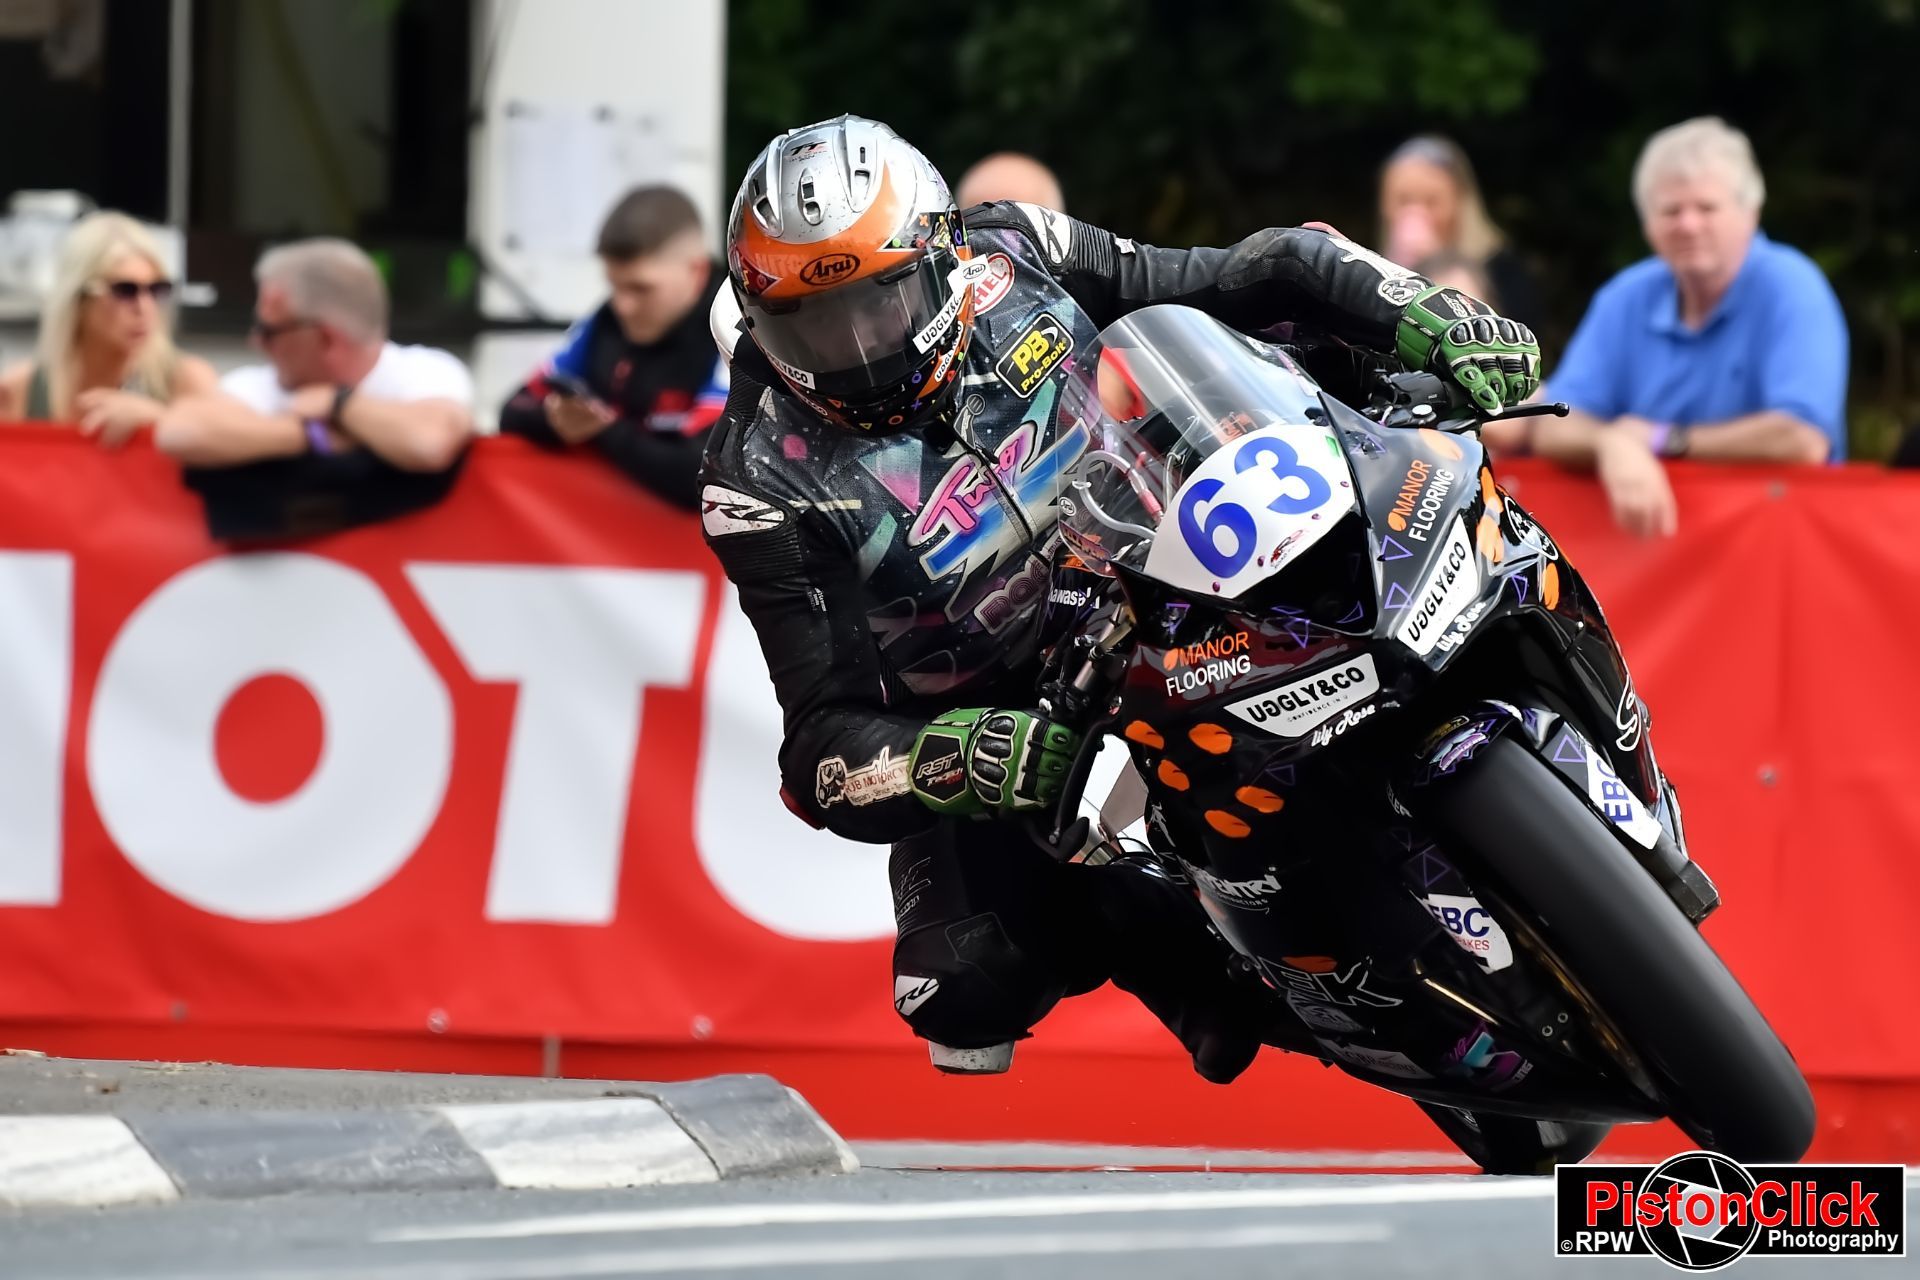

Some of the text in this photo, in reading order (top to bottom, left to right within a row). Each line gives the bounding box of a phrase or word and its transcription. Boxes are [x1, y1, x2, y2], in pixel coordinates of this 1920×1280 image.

[809, 256, 851, 279] Arai
[963, 264, 985, 277] Arai
[1011, 330, 1050, 375] PB
[1020, 340, 1067, 391] Pro-Bolt
[1178, 436, 1332, 579] 63
[1393, 459, 1432, 518] MANOR
[1408, 468, 1456, 542] FLOORING
[1178, 631, 1250, 668] MANOR
[1166, 655, 1251, 697] FLOORING
[916, 751, 959, 779] RST
[1455, 936, 1490, 951] AKES
